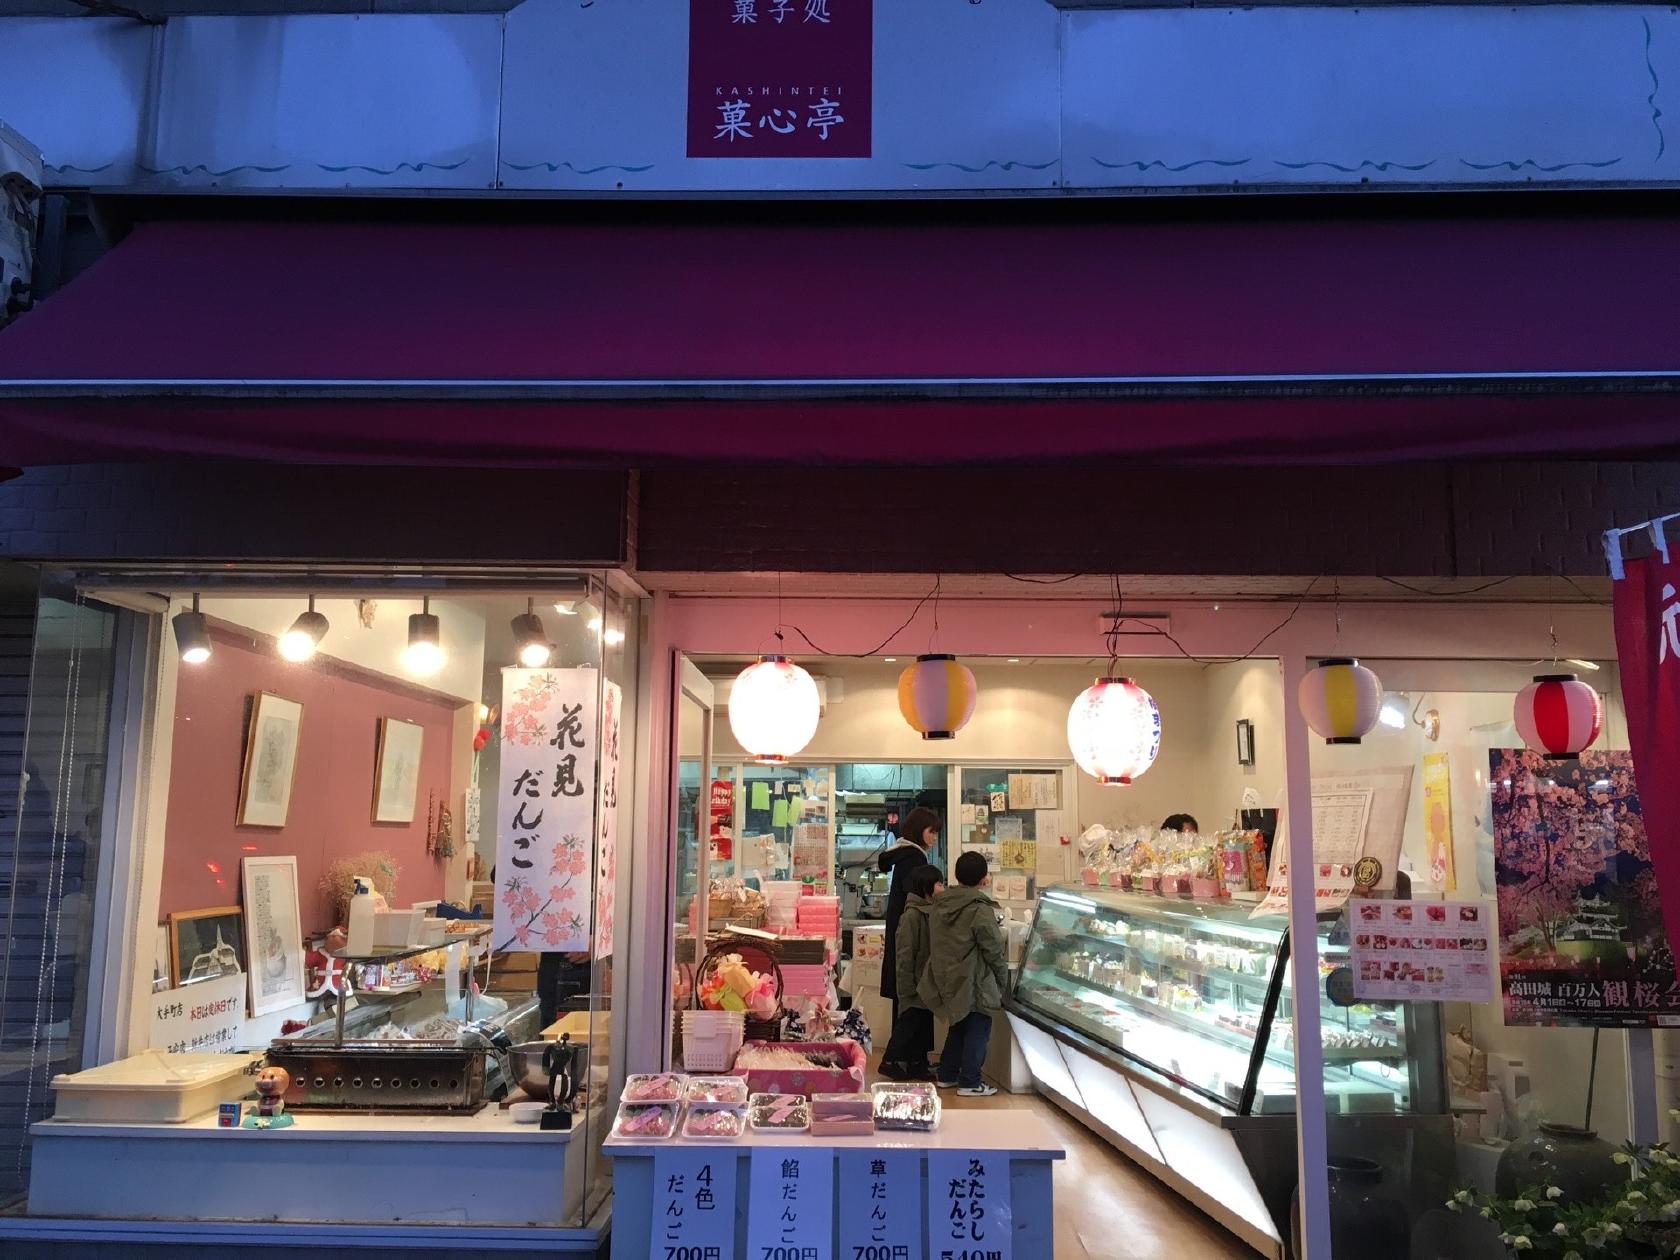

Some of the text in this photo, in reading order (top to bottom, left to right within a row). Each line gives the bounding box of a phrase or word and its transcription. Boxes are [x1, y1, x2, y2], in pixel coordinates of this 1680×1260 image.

[731, 0, 831, 24] 菓子処
[716, 86, 842, 95] KASHINTEI
[713, 98, 844, 142] 菓心亭
[550, 703, 585, 798] 花見
[511, 768, 544, 869] だんご
[1509, 981, 1551, 997] 高田城
[1558, 982, 1601, 998] 百万人
[666, 1174, 685, 1240] だんご
[695, 1165, 716, 1210] 4色
[780, 1158, 799, 1243] 餡だんご
[870, 1159, 887, 1242] 草だんご
[949, 1178, 967, 1239] だんご
[968, 1158, 986, 1241] みたらし
[664, 1247, 720, 1260] 700円
[761, 1247, 818, 1260] 700円
[852, 1246, 908, 1260] 700円
